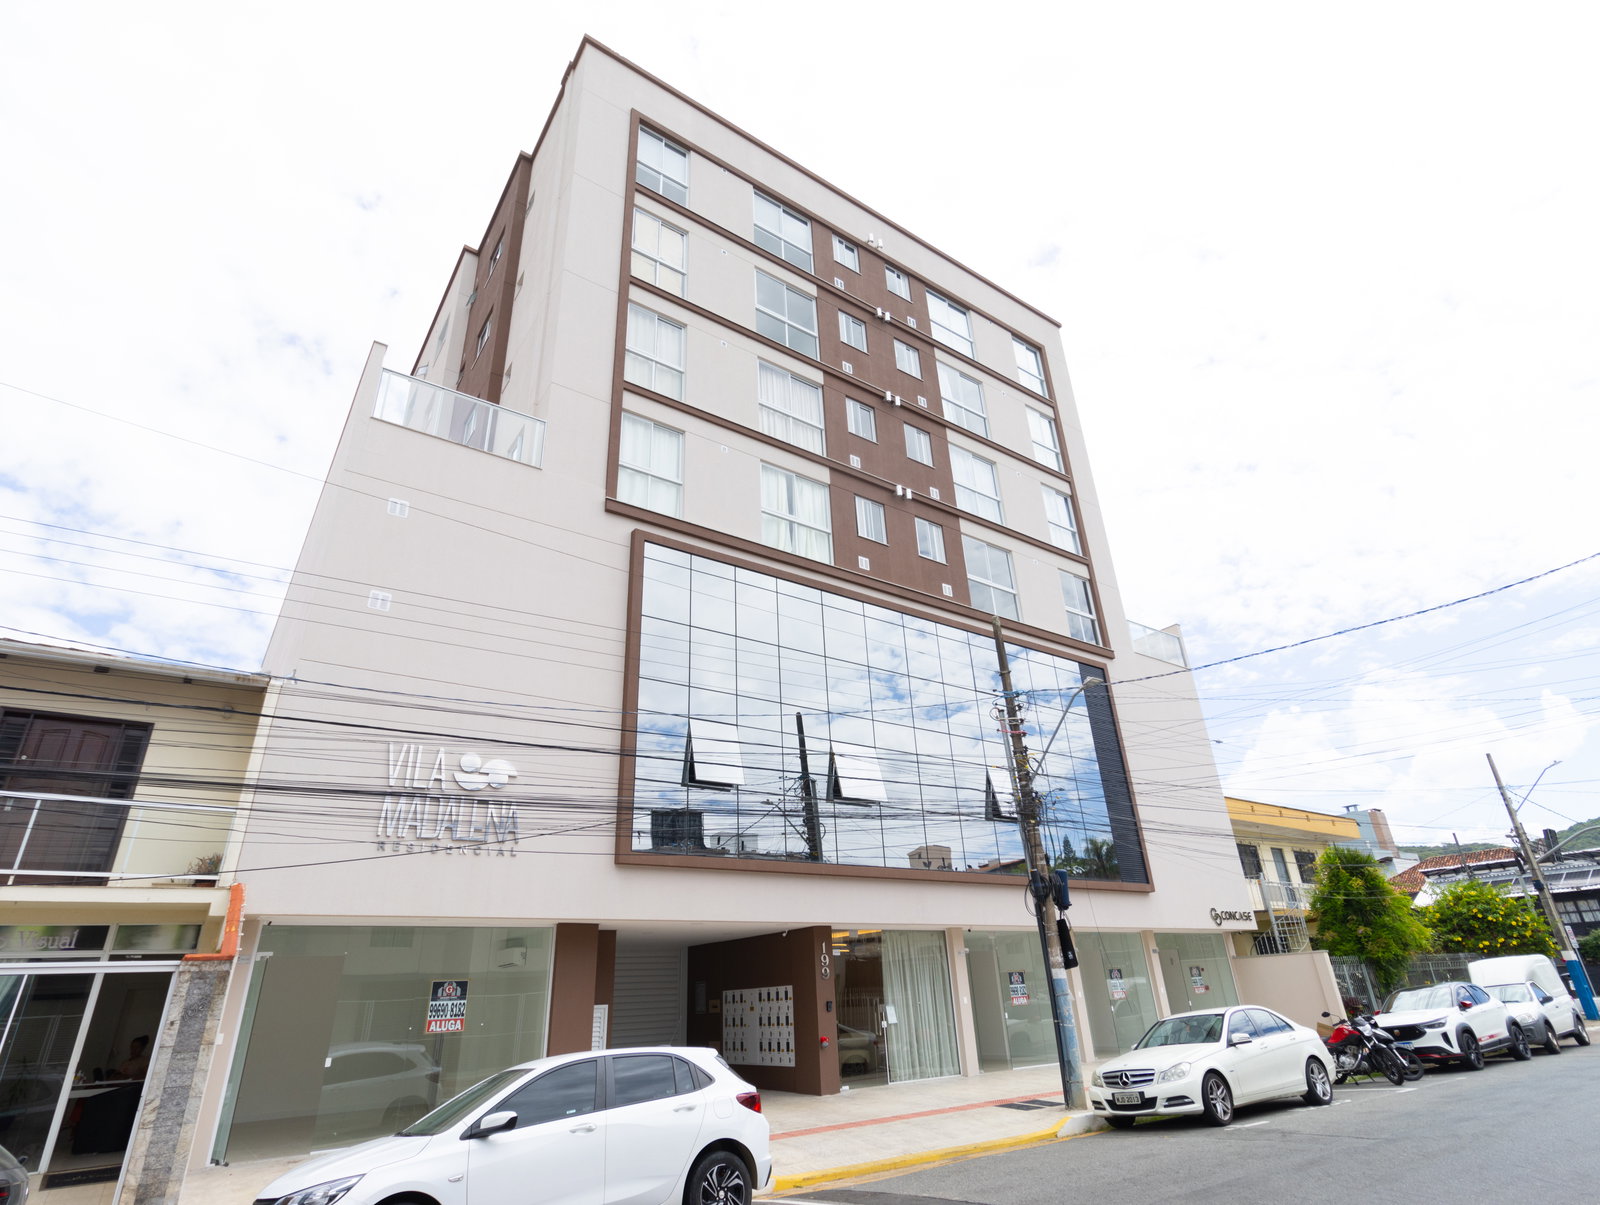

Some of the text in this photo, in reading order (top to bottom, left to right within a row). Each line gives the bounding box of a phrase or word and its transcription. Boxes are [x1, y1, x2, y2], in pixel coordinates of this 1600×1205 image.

[388, 743, 446, 791] VILA
[376, 794, 519, 844] MADALENA
[376, 841, 517, 857] RESIDENCIAL
[1220, 910, 1252, 921] CONCASE
[17, 929, 80, 949] Visual
[821, 941, 830, 980] 199
[429, 1020, 462, 1031] ALUGA
